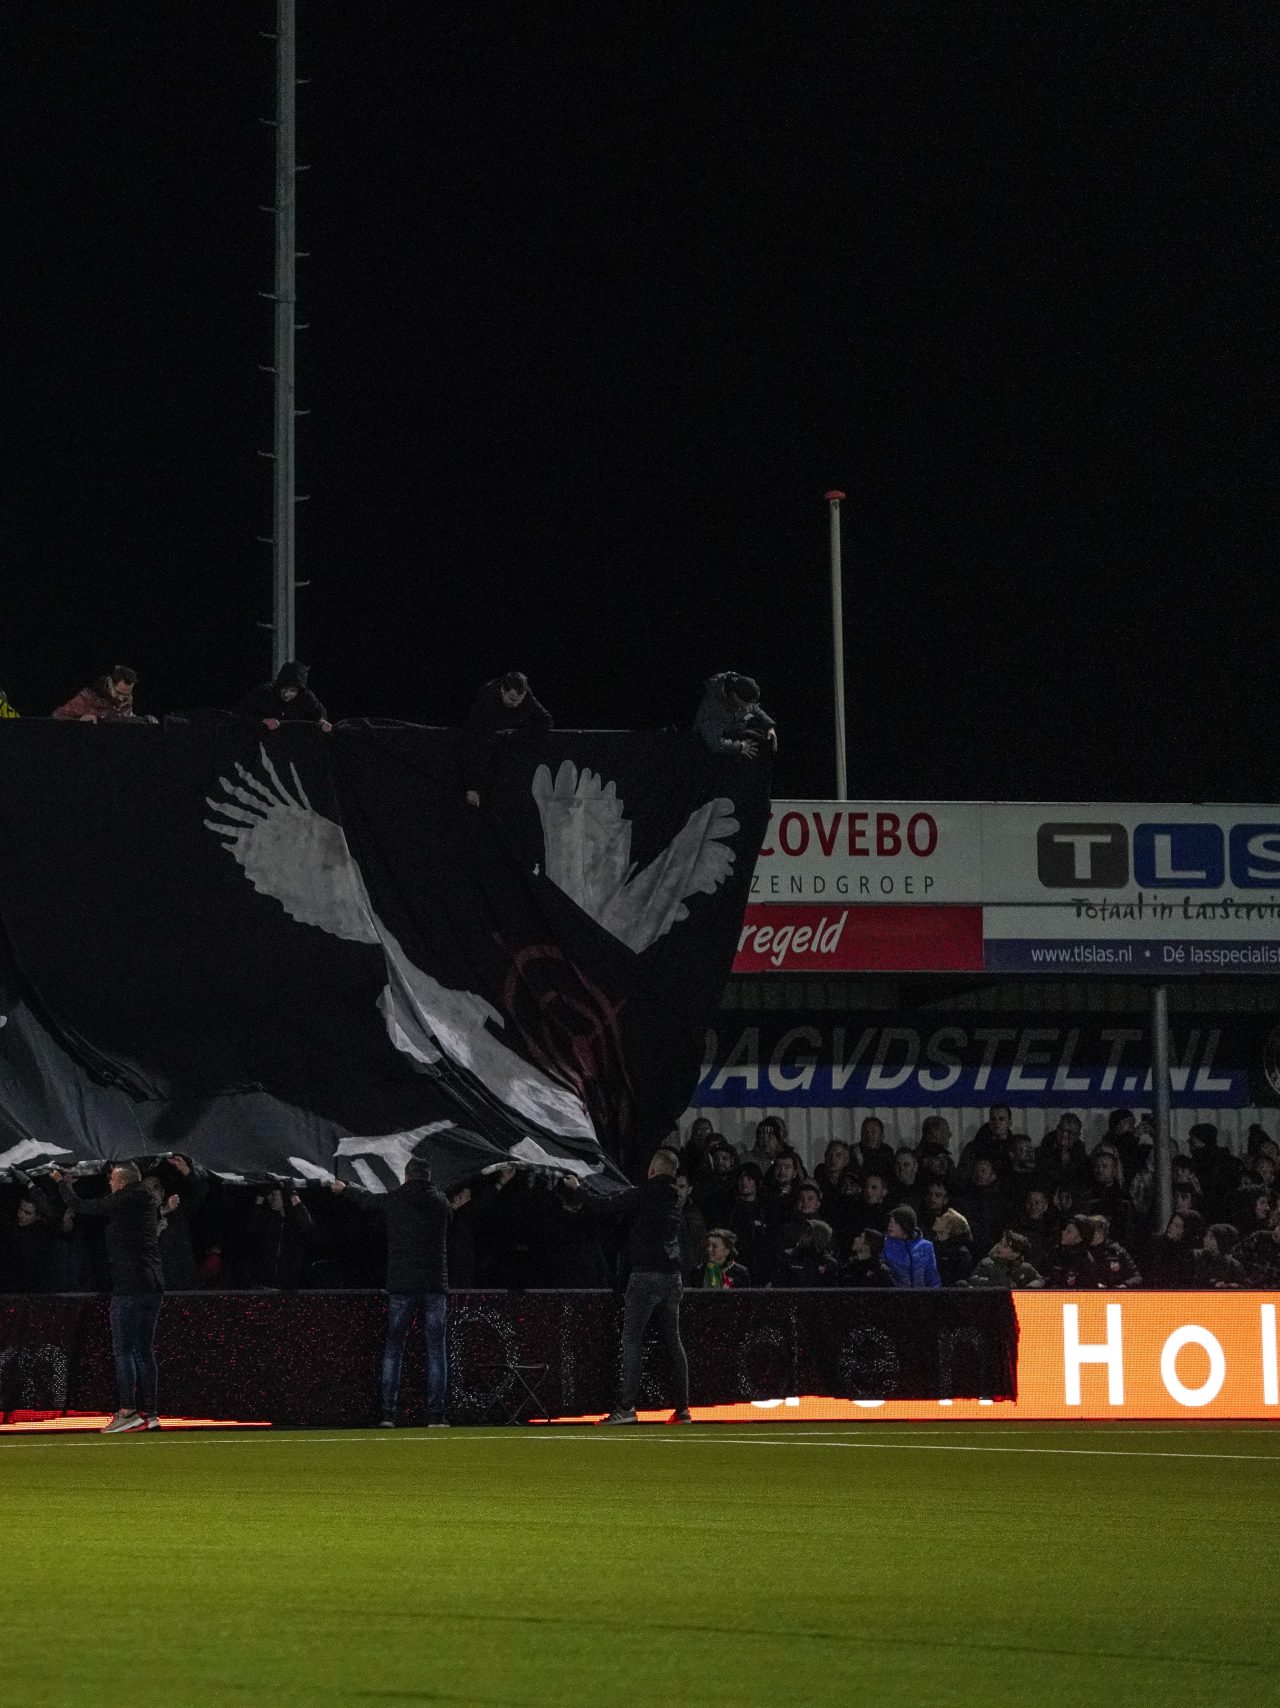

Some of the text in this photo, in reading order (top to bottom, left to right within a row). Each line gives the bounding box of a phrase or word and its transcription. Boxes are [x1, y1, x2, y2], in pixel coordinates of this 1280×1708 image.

[757, 812, 938, 857] OVEBO
[1071, 892, 1144, 922] Totaal
[1153, 895, 1173, 920] in
[1031, 945, 1133, 963] www.tlslas.nl
[1163, 944, 1186, 963] Dé
